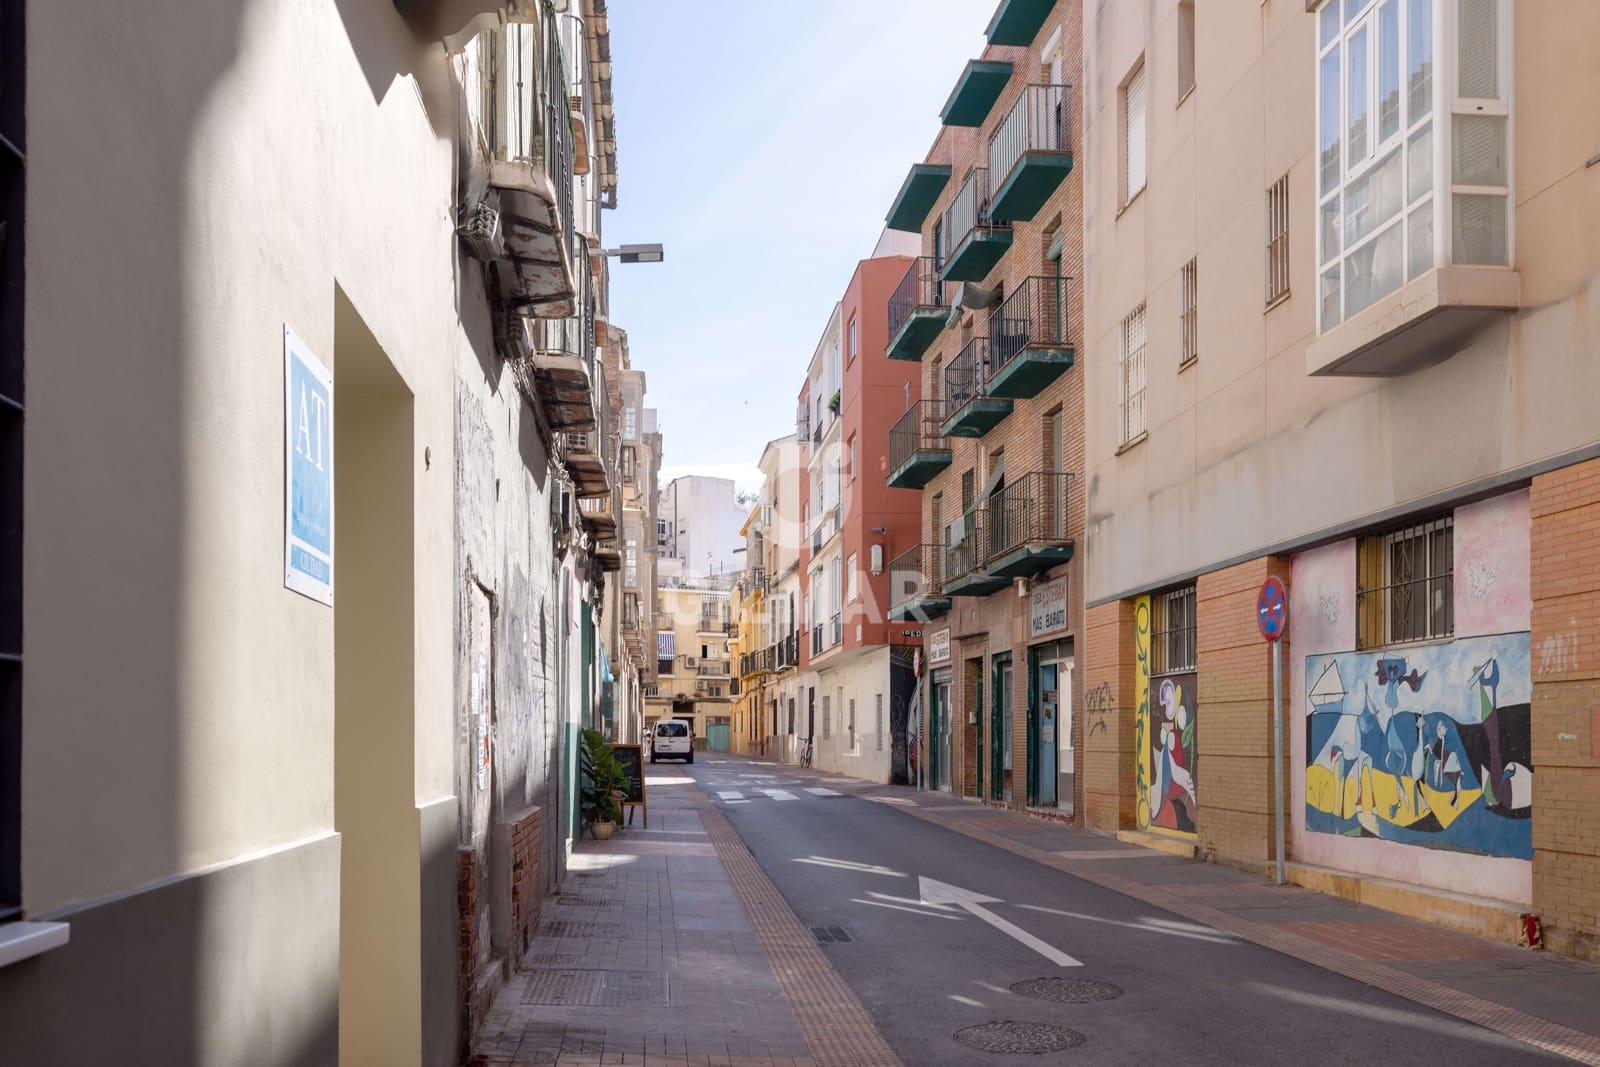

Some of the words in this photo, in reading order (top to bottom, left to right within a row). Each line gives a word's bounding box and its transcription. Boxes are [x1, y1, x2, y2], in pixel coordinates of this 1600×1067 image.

[295, 377, 326, 472] AT
[1032, 616, 1043, 632] MAS
[1045, 609, 1065, 628] BARATO
